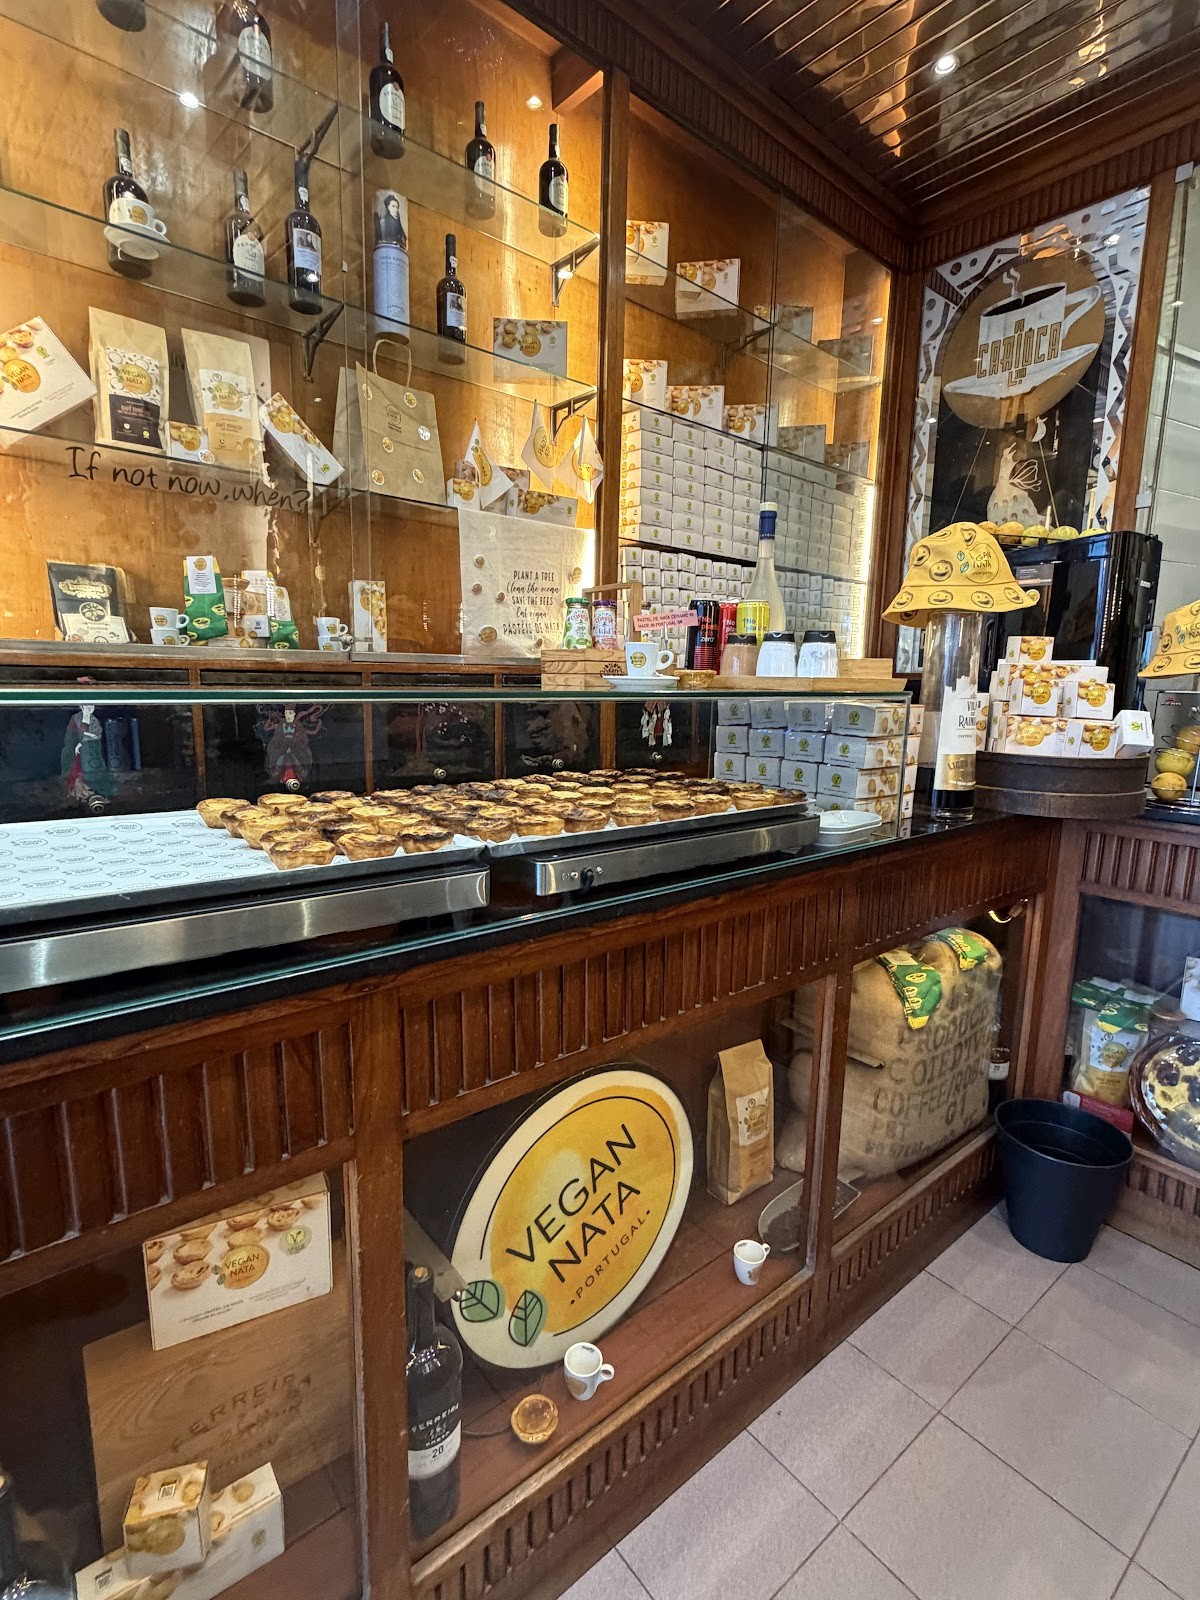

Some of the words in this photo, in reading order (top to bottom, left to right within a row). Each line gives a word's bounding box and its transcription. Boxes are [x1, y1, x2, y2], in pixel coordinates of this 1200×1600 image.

[1014, 318, 1025, 334] A
[7, 365, 30, 379] VEGAN
[121, 369, 147, 381] VEGAN
[16, 373, 33, 385] NATA
[126, 377, 144, 386] NATA
[65, 446, 102, 482] If
[112, 467, 159, 490] not
[513, 570, 533, 581] PLANT
[535, 571, 539, 581] A
[541, 571, 555, 582] TREE
[527, 581, 539, 594] the
[527, 596, 538, 606] THE
[539, 596, 554, 606] BEES
[505, 1123, 637, 1263] VEGAN
[548, 1181, 641, 1284] NATA
[224, 1253, 260, 1270] VEGAN
[229, 1264, 256, 1277] NATA
[431, 1444, 444, 1459] 20
